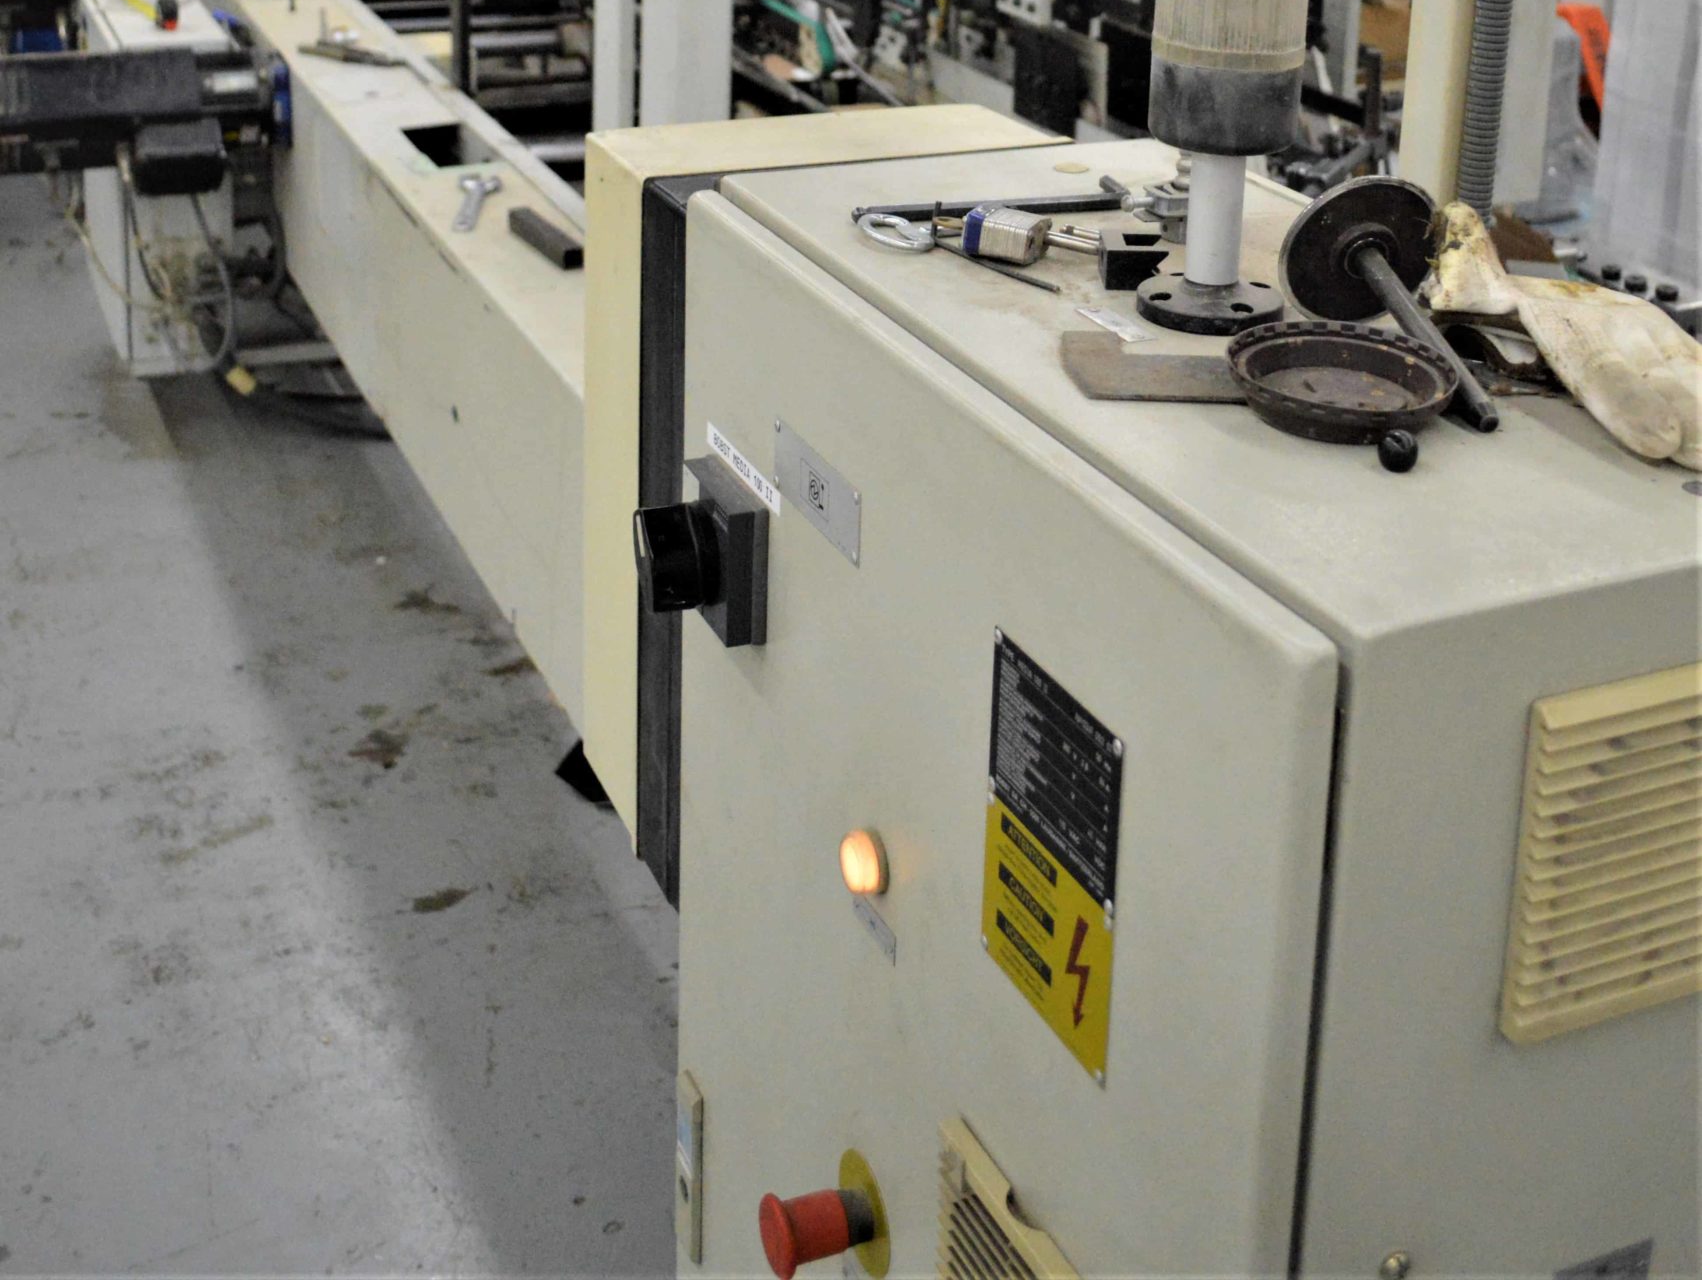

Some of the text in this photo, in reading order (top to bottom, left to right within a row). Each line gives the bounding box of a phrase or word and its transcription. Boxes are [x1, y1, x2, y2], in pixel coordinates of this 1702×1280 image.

[733, 452, 750, 478] MEDIA
[1008, 825, 1050, 877] ATTENTION
[1008, 876, 1043, 925] CAUTION
